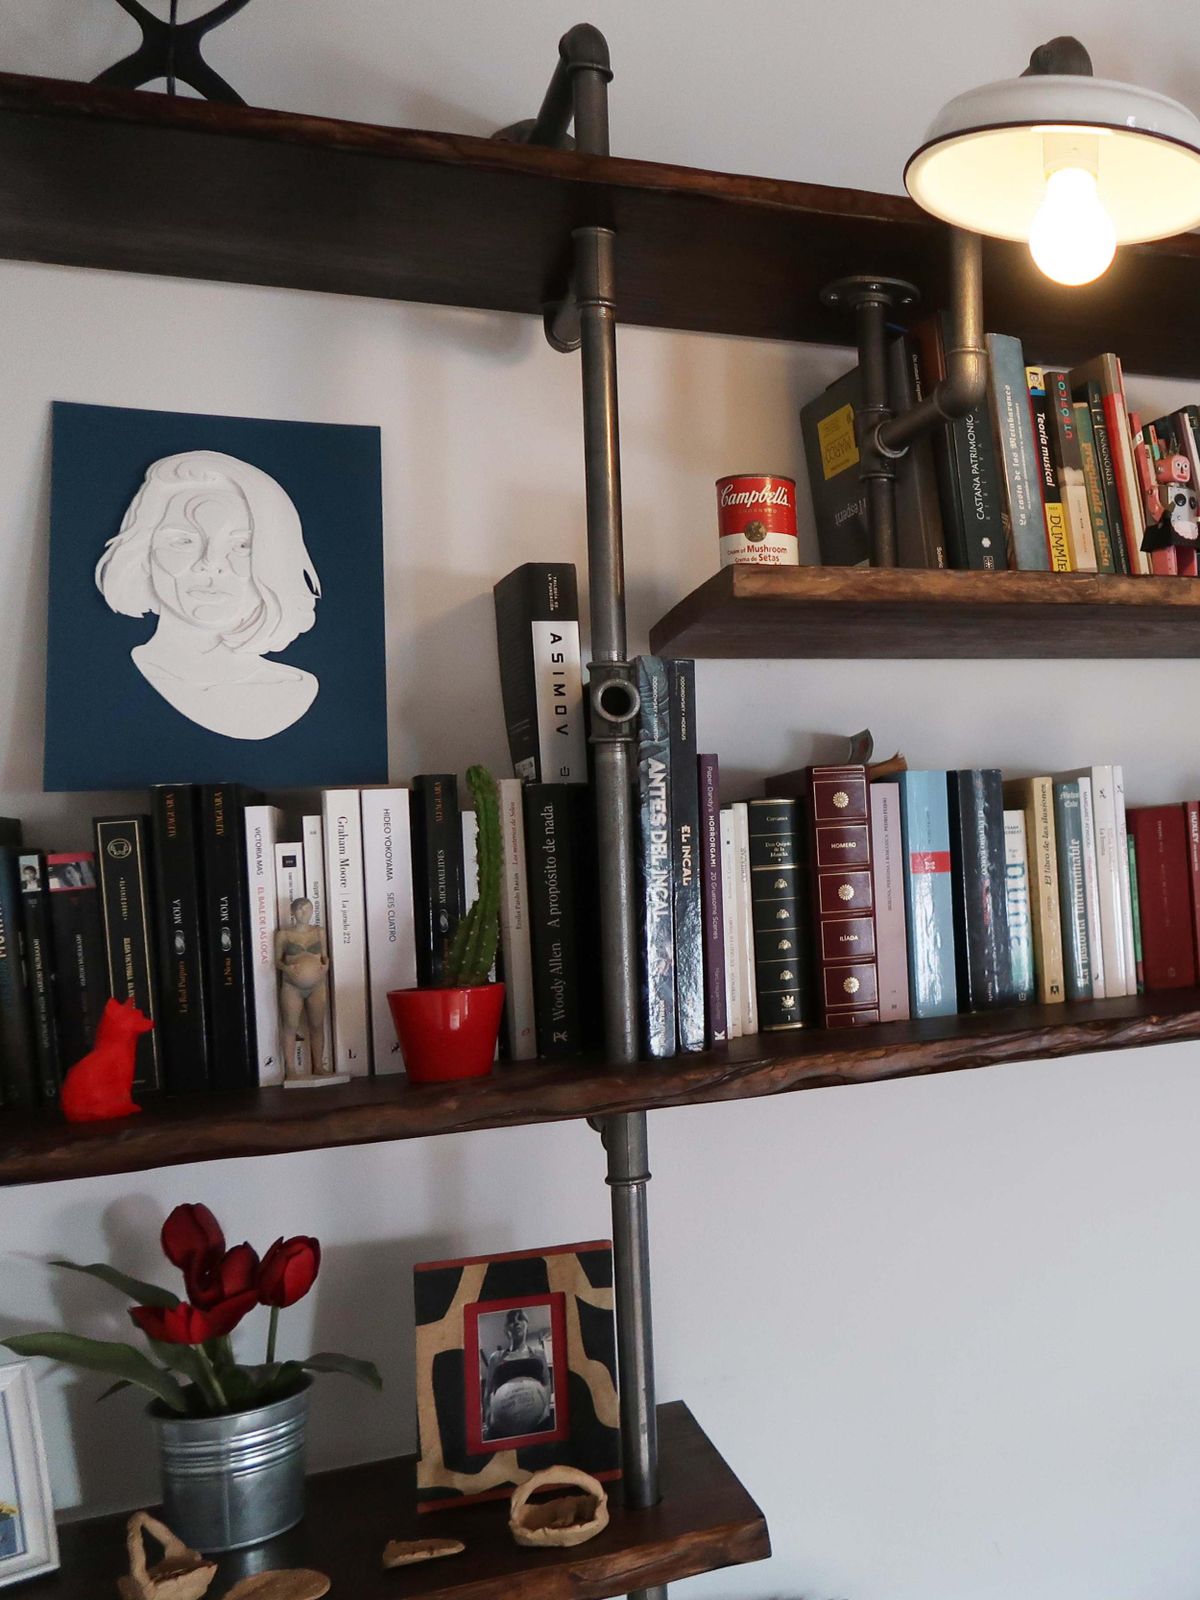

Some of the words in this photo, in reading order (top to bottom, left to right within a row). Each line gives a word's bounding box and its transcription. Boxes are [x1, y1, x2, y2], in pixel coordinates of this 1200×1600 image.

[1036, 412, 1048, 444] Teoría
[1014, 471, 1021, 484] de
[1041, 447, 1055, 488] musical
[720, 484, 790, 507] Campbell's
[972, 476, 985, 520] CASTAÑA
[1017, 488, 1025, 512] casta
[746, 545, 787, 553] Mushroom
[1050, 515, 1068, 572] DUMMIE
[759, 554, 780, 562] Setas
[550, 632, 568, 737] ASIMOV
[706, 766, 714, 785] Paper
[648, 757, 668, 826] ANTES
[706, 787, 715, 812] Dandy's
[1040, 783, 1048, 824] ilusiones
[167, 793, 178, 839] ALFAGUARA
[214, 791, 224, 837] ALFAGUARA
[383, 808, 392, 834] HIDEO
[1190, 811, 1199, 843] HUXLEY
[254, 826, 263, 859] VICTORIA
[337, 816, 349, 854] Graham
[542, 837, 557, 852] de
[681, 825, 692, 843] EL
[708, 815, 717, 868] HORRORGAMI
[1041, 826, 1049, 838] las
[384, 835, 394, 881] YOKOYAMA
[650, 827, 668, 866] DEL
[831, 841, 857, 850] HOMERO
[1042, 840, 1049, 851] de
[256, 860, 264, 876] MAS
[339, 858, 351, 888] Moore
[439, 849, 447, 904] MICHAELIDES
[681, 845, 692, 886] INCAL
[710, 871, 718, 881] 20
[1043, 853, 1051, 874] libro
[1069, 838, 1084, 913] interminable
[542, 855, 562, 915] propósito
[1044, 875, 1052, 886] El
[257, 896, 266, 915] BAILE
[386, 892, 395, 909] SEIS
[650, 867, 669, 922] INCAL
[710, 882, 719, 914] Gruesome
[173, 898, 182, 924] MOLA
[219, 896, 229, 921] MOLA
[259, 927, 268, 939] LAS
[387, 909, 397, 943] CUATRO
[546, 917, 560, 928] A
[711, 916, 720, 939] Scenes
[839, 933, 859, 942] ILÍADA
[260, 940, 269, 964] LOCAS
[549, 977, 568, 1021] Woody
[714, 1029, 725, 1041] K
